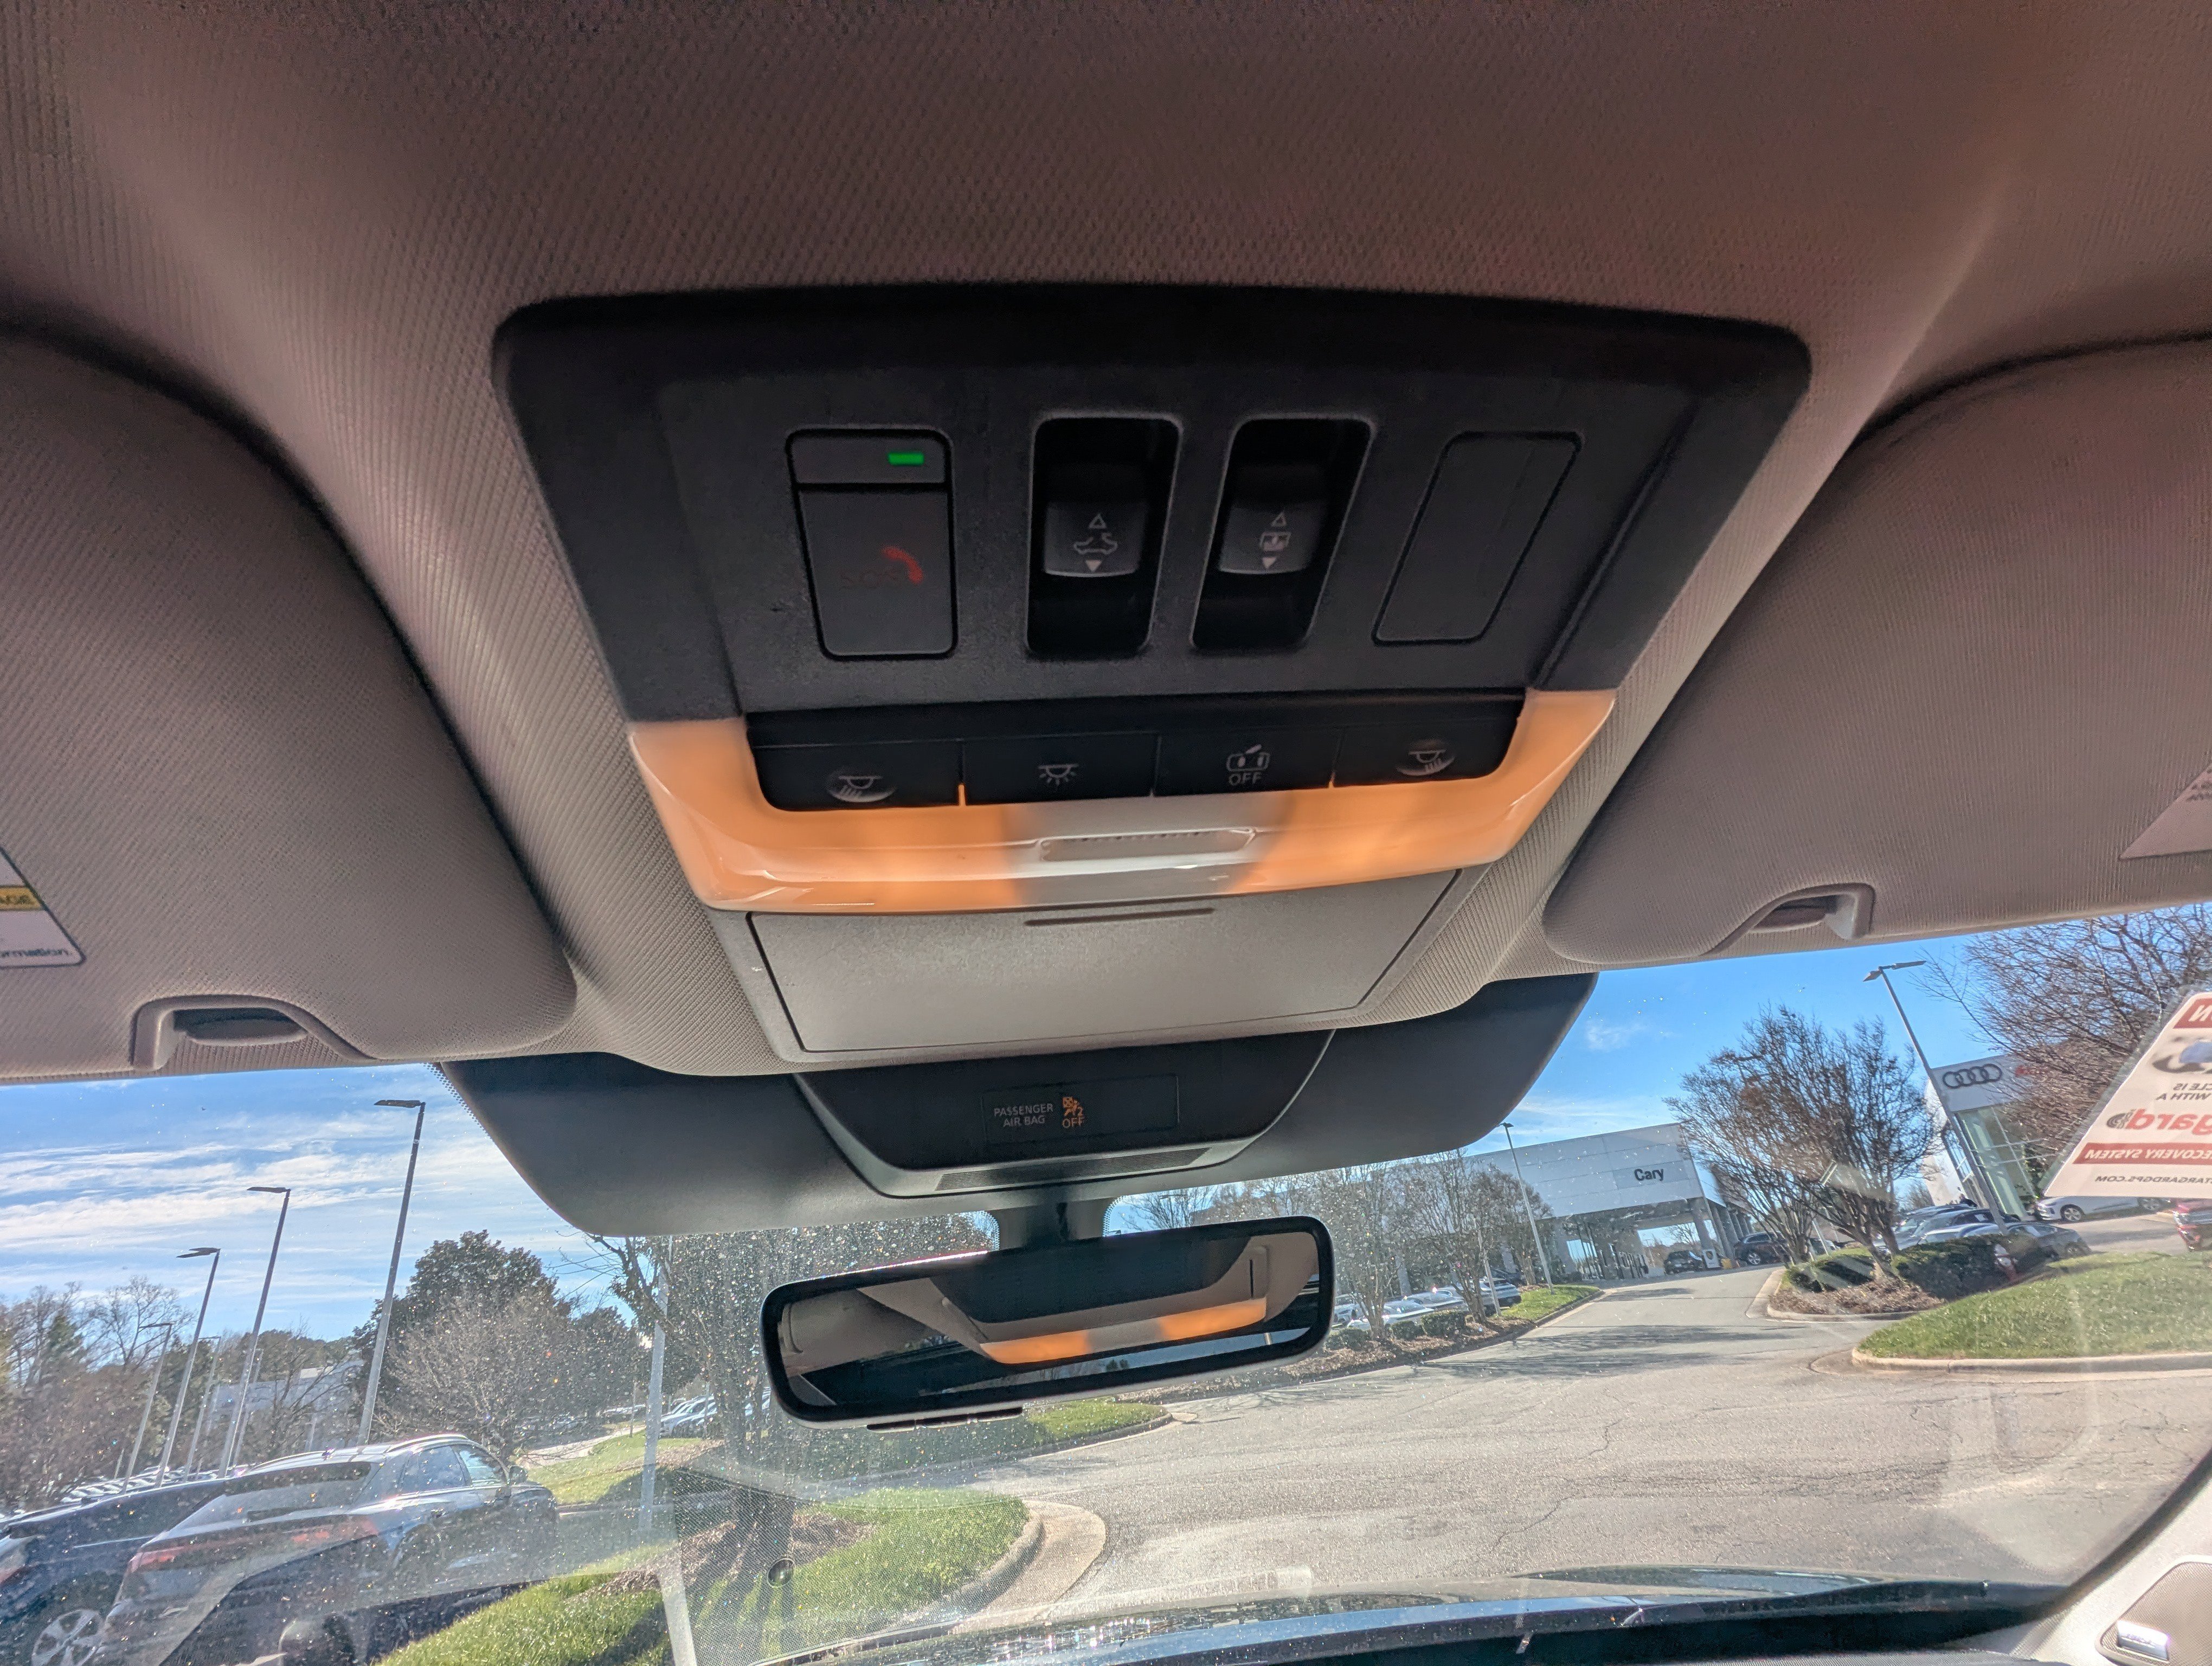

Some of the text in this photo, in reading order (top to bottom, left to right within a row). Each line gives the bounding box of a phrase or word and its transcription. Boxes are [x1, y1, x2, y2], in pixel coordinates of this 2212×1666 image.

[1228, 772, 1262, 786] OFF
[994, 1103, 1053, 1117] PASSENGER
[1003, 1115, 1045, 1127] AIR BAG
[1062, 1117, 1085, 1129] OFF
[1634, 1168, 1664, 1182] Cary
